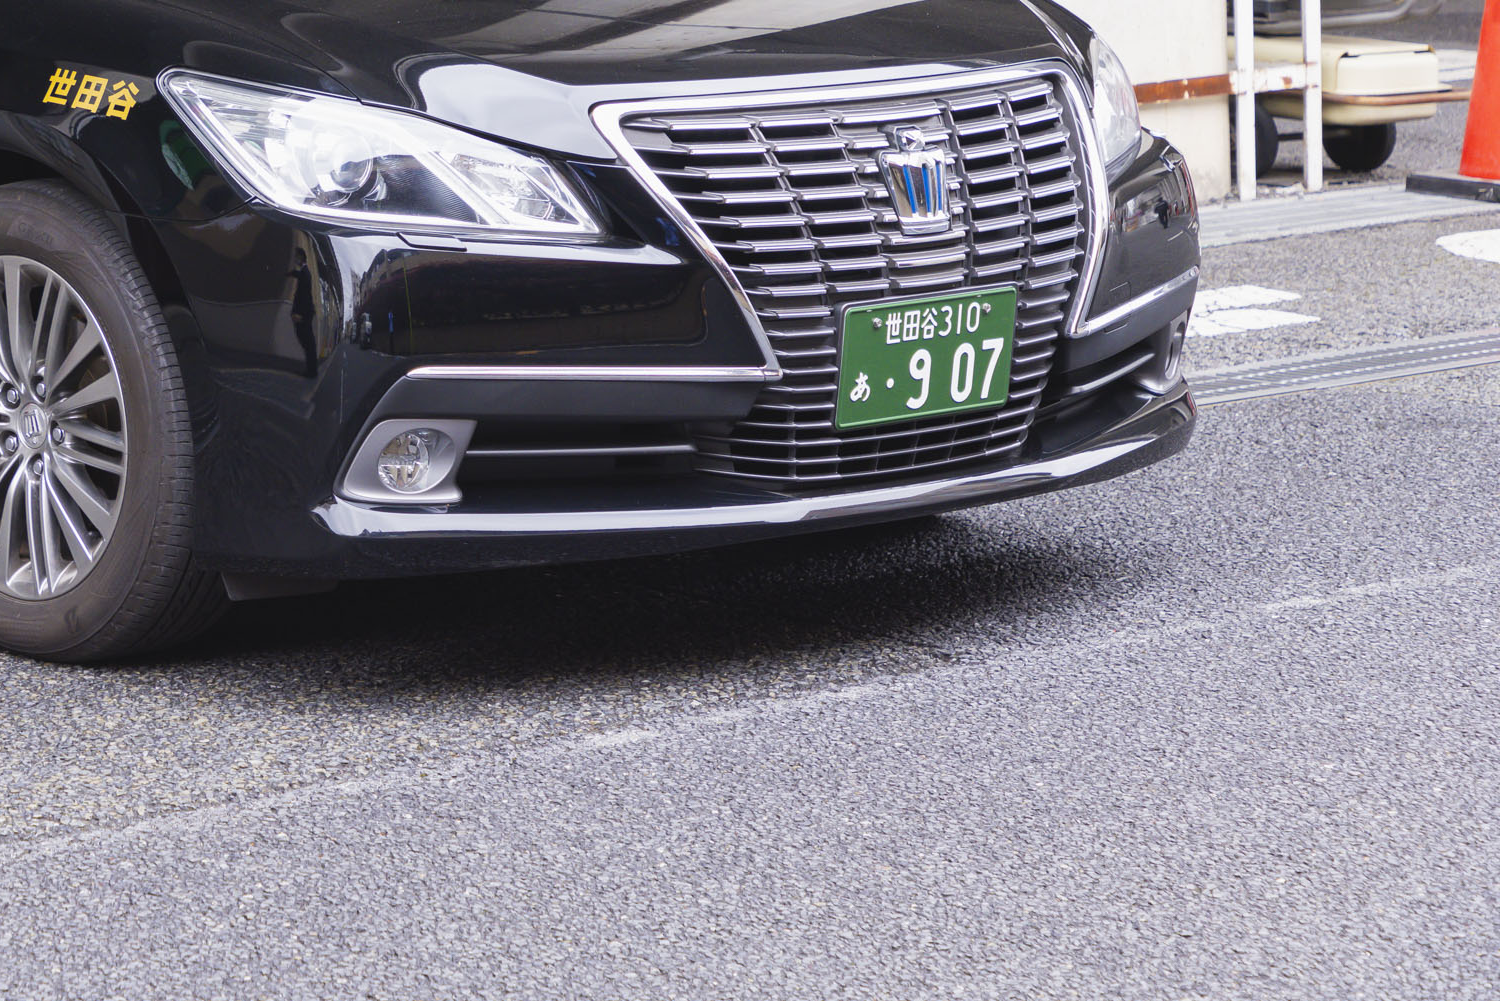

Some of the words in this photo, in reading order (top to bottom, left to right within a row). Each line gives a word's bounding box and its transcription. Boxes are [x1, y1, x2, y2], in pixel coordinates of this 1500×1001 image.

[43, 68, 139, 121] 世田谷
[885, 302, 981, 345] 世田谷310
